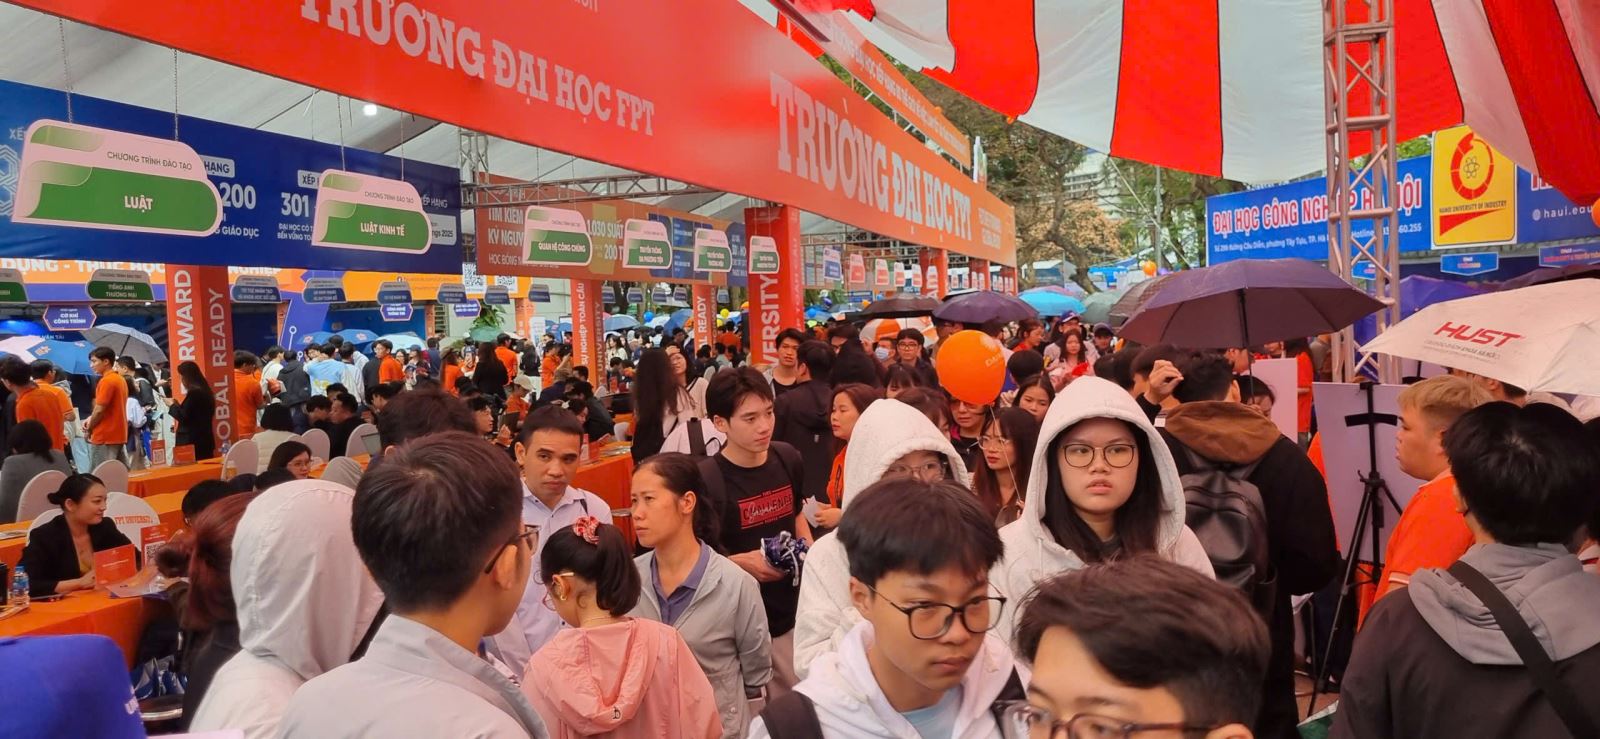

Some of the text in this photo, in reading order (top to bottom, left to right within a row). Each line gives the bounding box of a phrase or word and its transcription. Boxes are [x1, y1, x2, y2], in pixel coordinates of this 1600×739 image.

[492, 39, 549, 104] ĐẠI
[555, 64, 611, 123] HỌC
[617, 89, 654, 136] FPT
[9, 128, 26, 141] XẾ
[107, 151, 192, 171] CHƯƠNG TRÌNH ĐÀO TẠO
[770, 71, 889, 213] TRƯỜNG
[891, 152, 923, 235] ĐẠI
[923, 171, 952, 243] HỌC
[952, 187, 972, 241] FPT
[302, 173, 316, 185] XẾP
[124, 194, 153, 213] LUẬT
[281, 192, 310, 218] 301
[422, 193, 430, 206] ẾP
[1452, 203, 1477, 212] UNIVERSITY
[1484, 200, 1507, 209] INDUSTRY
[360, 221, 405, 236] LUẬT KINH TẾ
[1213, 210, 1233, 239] ĐẠI
[1234, 206, 1260, 237] HỌC
[1262, 197, 1299, 230] CÔNG
[221, 225, 242, 236] GIÁO
[243, 227, 260, 239] DỤC
[577, 301, 586, 323] TOÀN
[697, 296, 708, 333] READY
[208, 288, 228, 367] READY
[1433, 321, 1522, 348] HUST
